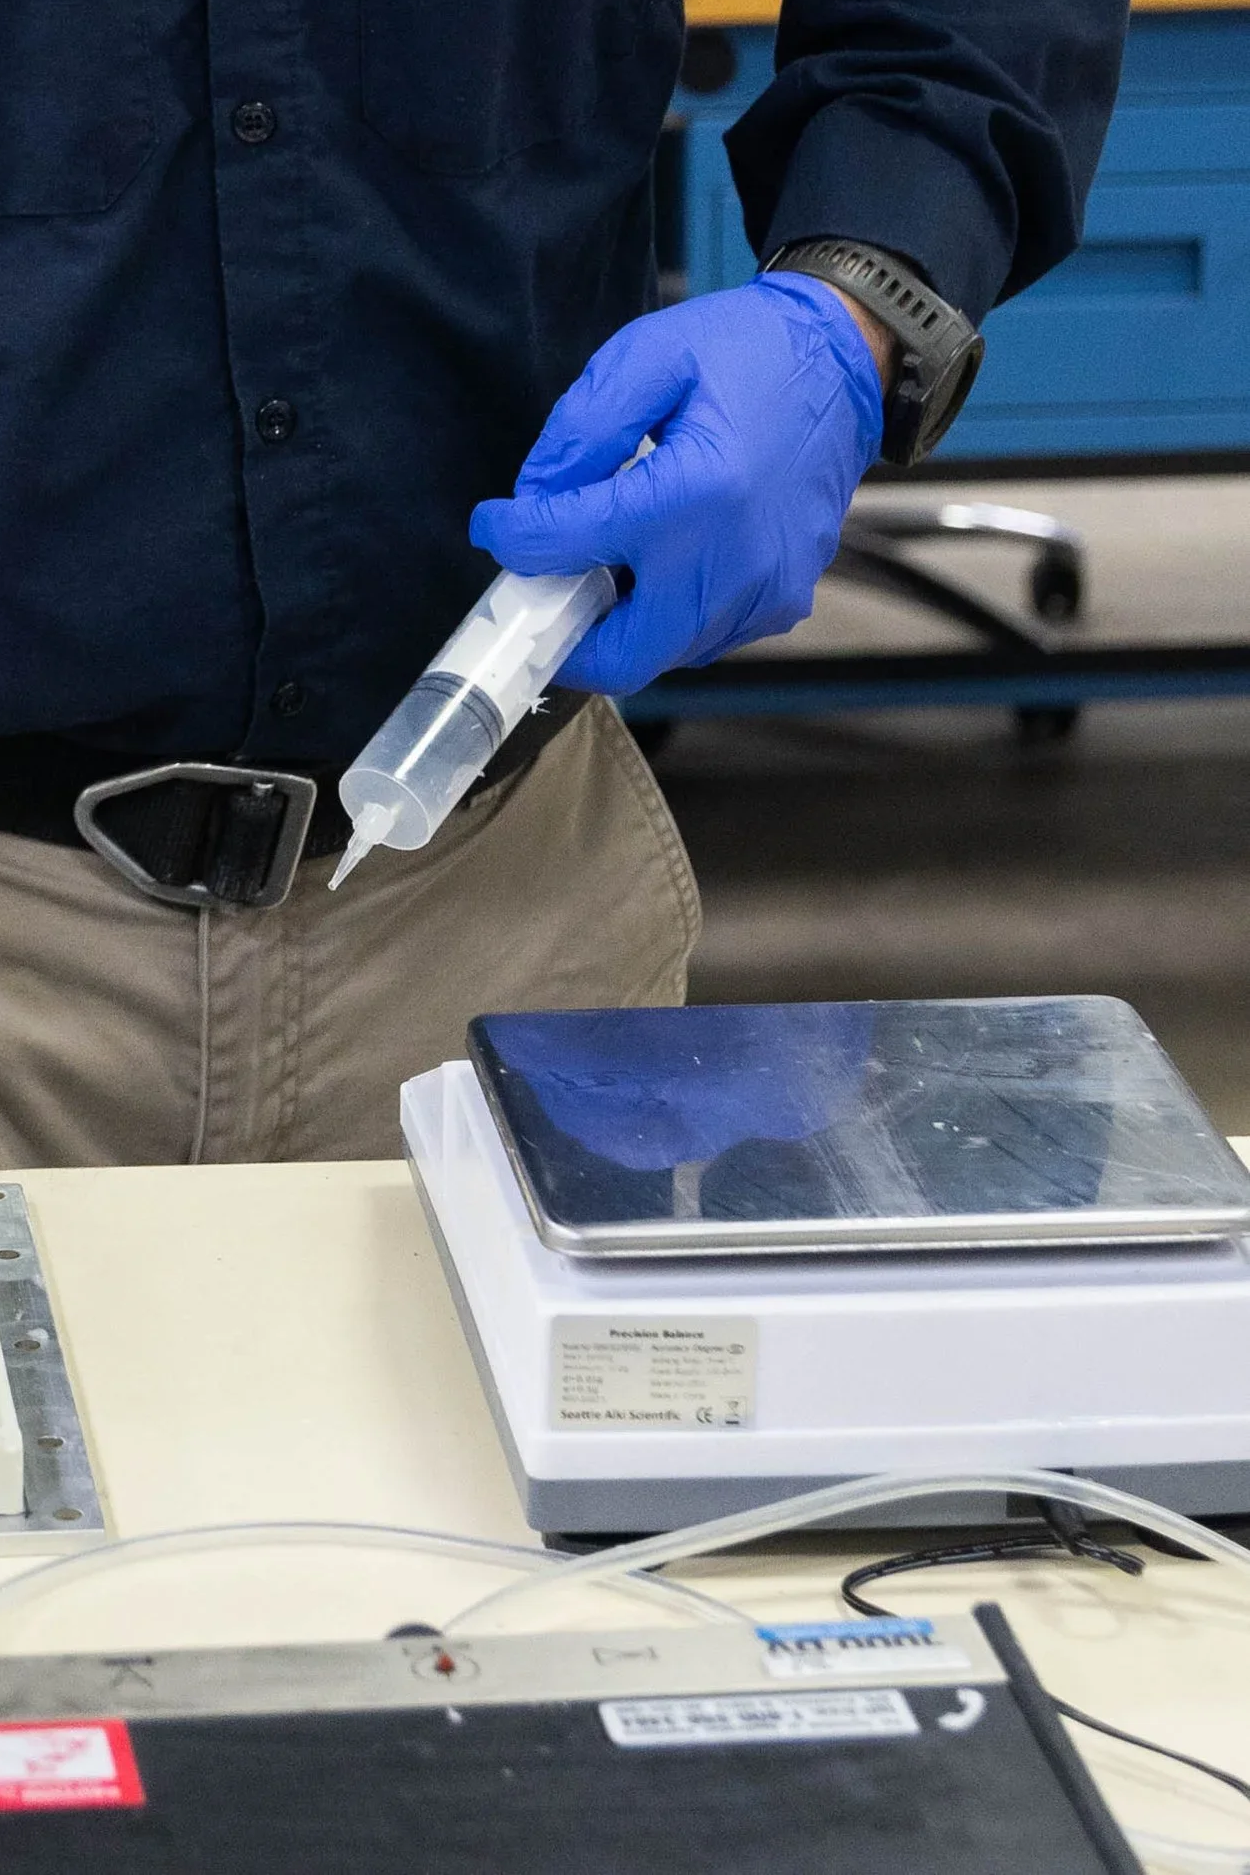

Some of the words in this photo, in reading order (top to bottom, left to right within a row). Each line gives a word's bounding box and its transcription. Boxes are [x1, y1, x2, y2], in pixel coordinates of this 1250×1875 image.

[609, 1328, 659, 1339] Precision
[662, 1328, 705, 1339] Balance
[560, 1409, 602, 1420] Seattle
[629, 1409, 682, 1420] Scientific
